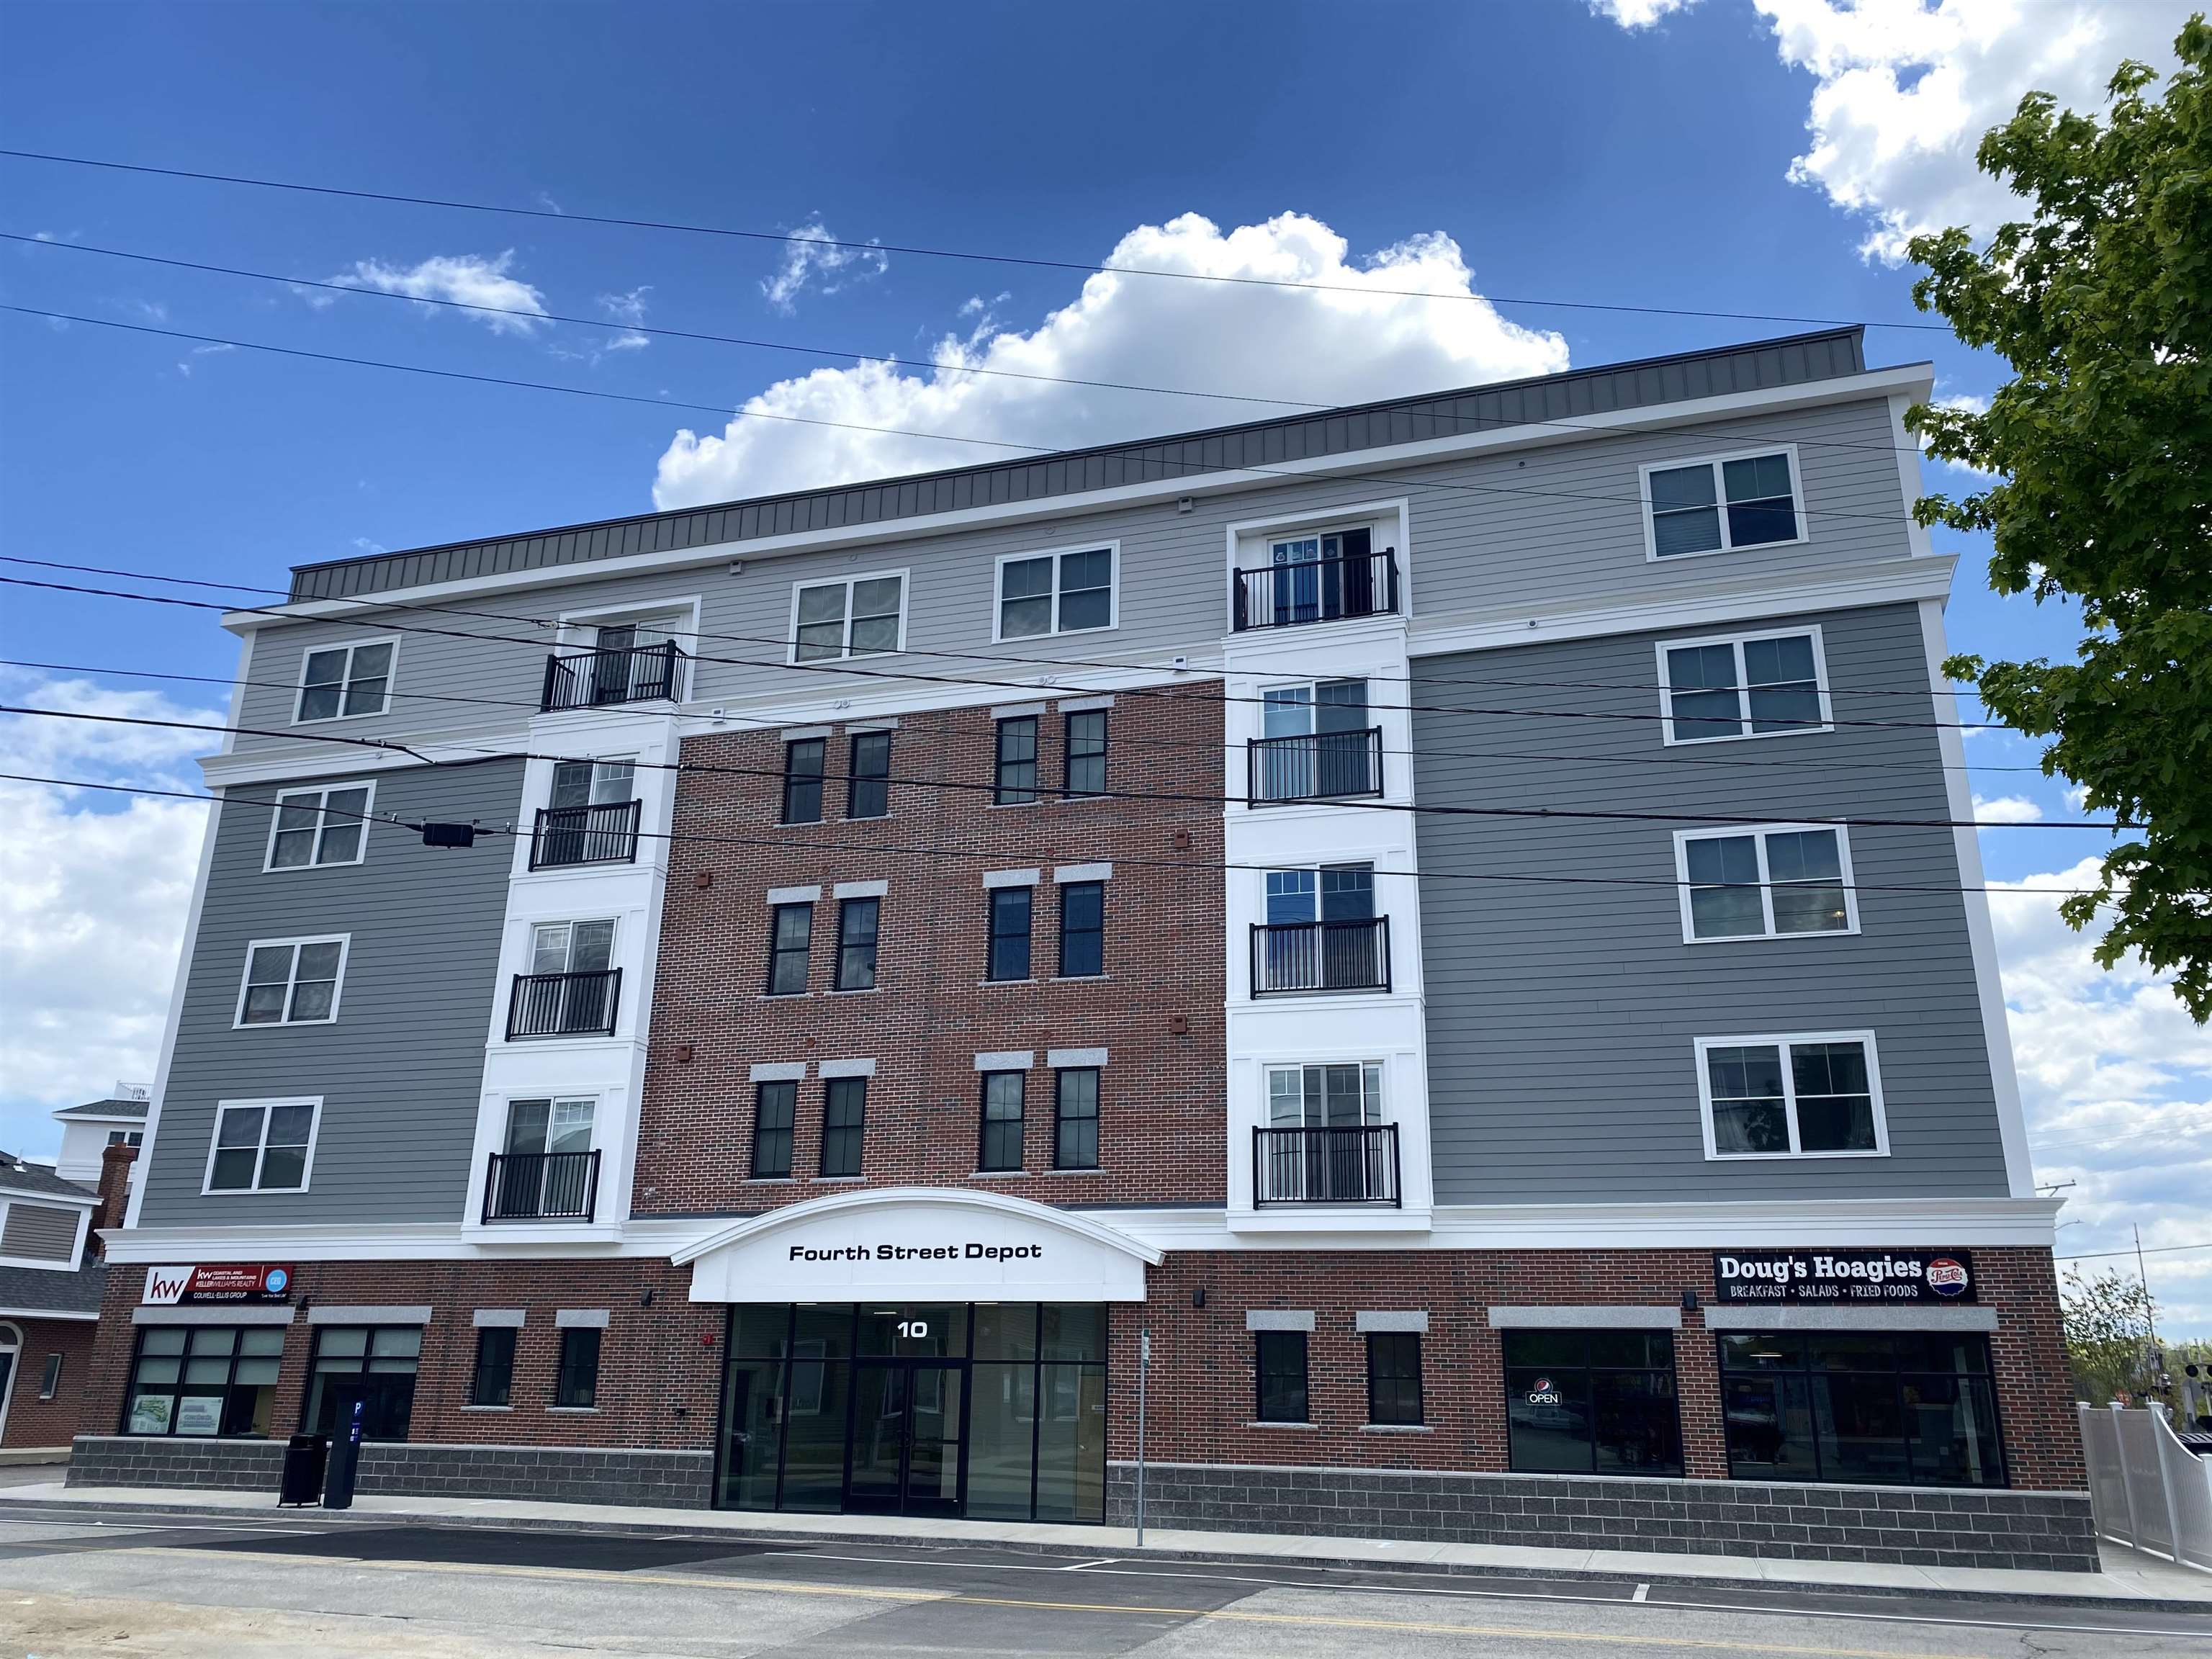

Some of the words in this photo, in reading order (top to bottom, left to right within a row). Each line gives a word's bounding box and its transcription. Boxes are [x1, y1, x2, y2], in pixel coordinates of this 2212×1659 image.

[789, 1245, 871, 1261] Fourth
[876, 1244, 959, 1260] Street
[965, 1244, 1042, 1263] Depot
[197, 1269, 213, 1280] kw
[1719, 1255, 1807, 1283] Doug's
[1813, 1255, 1923, 1283] Hoagies
[150, 1272, 184, 1299] kw
[1730, 1285, 1787, 1297] BREAKFAST
[1799, 1285, 1839, 1297] SALADS
[1851, 1285, 1881, 1297] FRIED
[1884, 1285, 1919, 1297] FOODS
[897, 1321, 928, 1338] 10
[1529, 1393, 1558, 1403] OPEN
[354, 1402, 361, 1414] P
